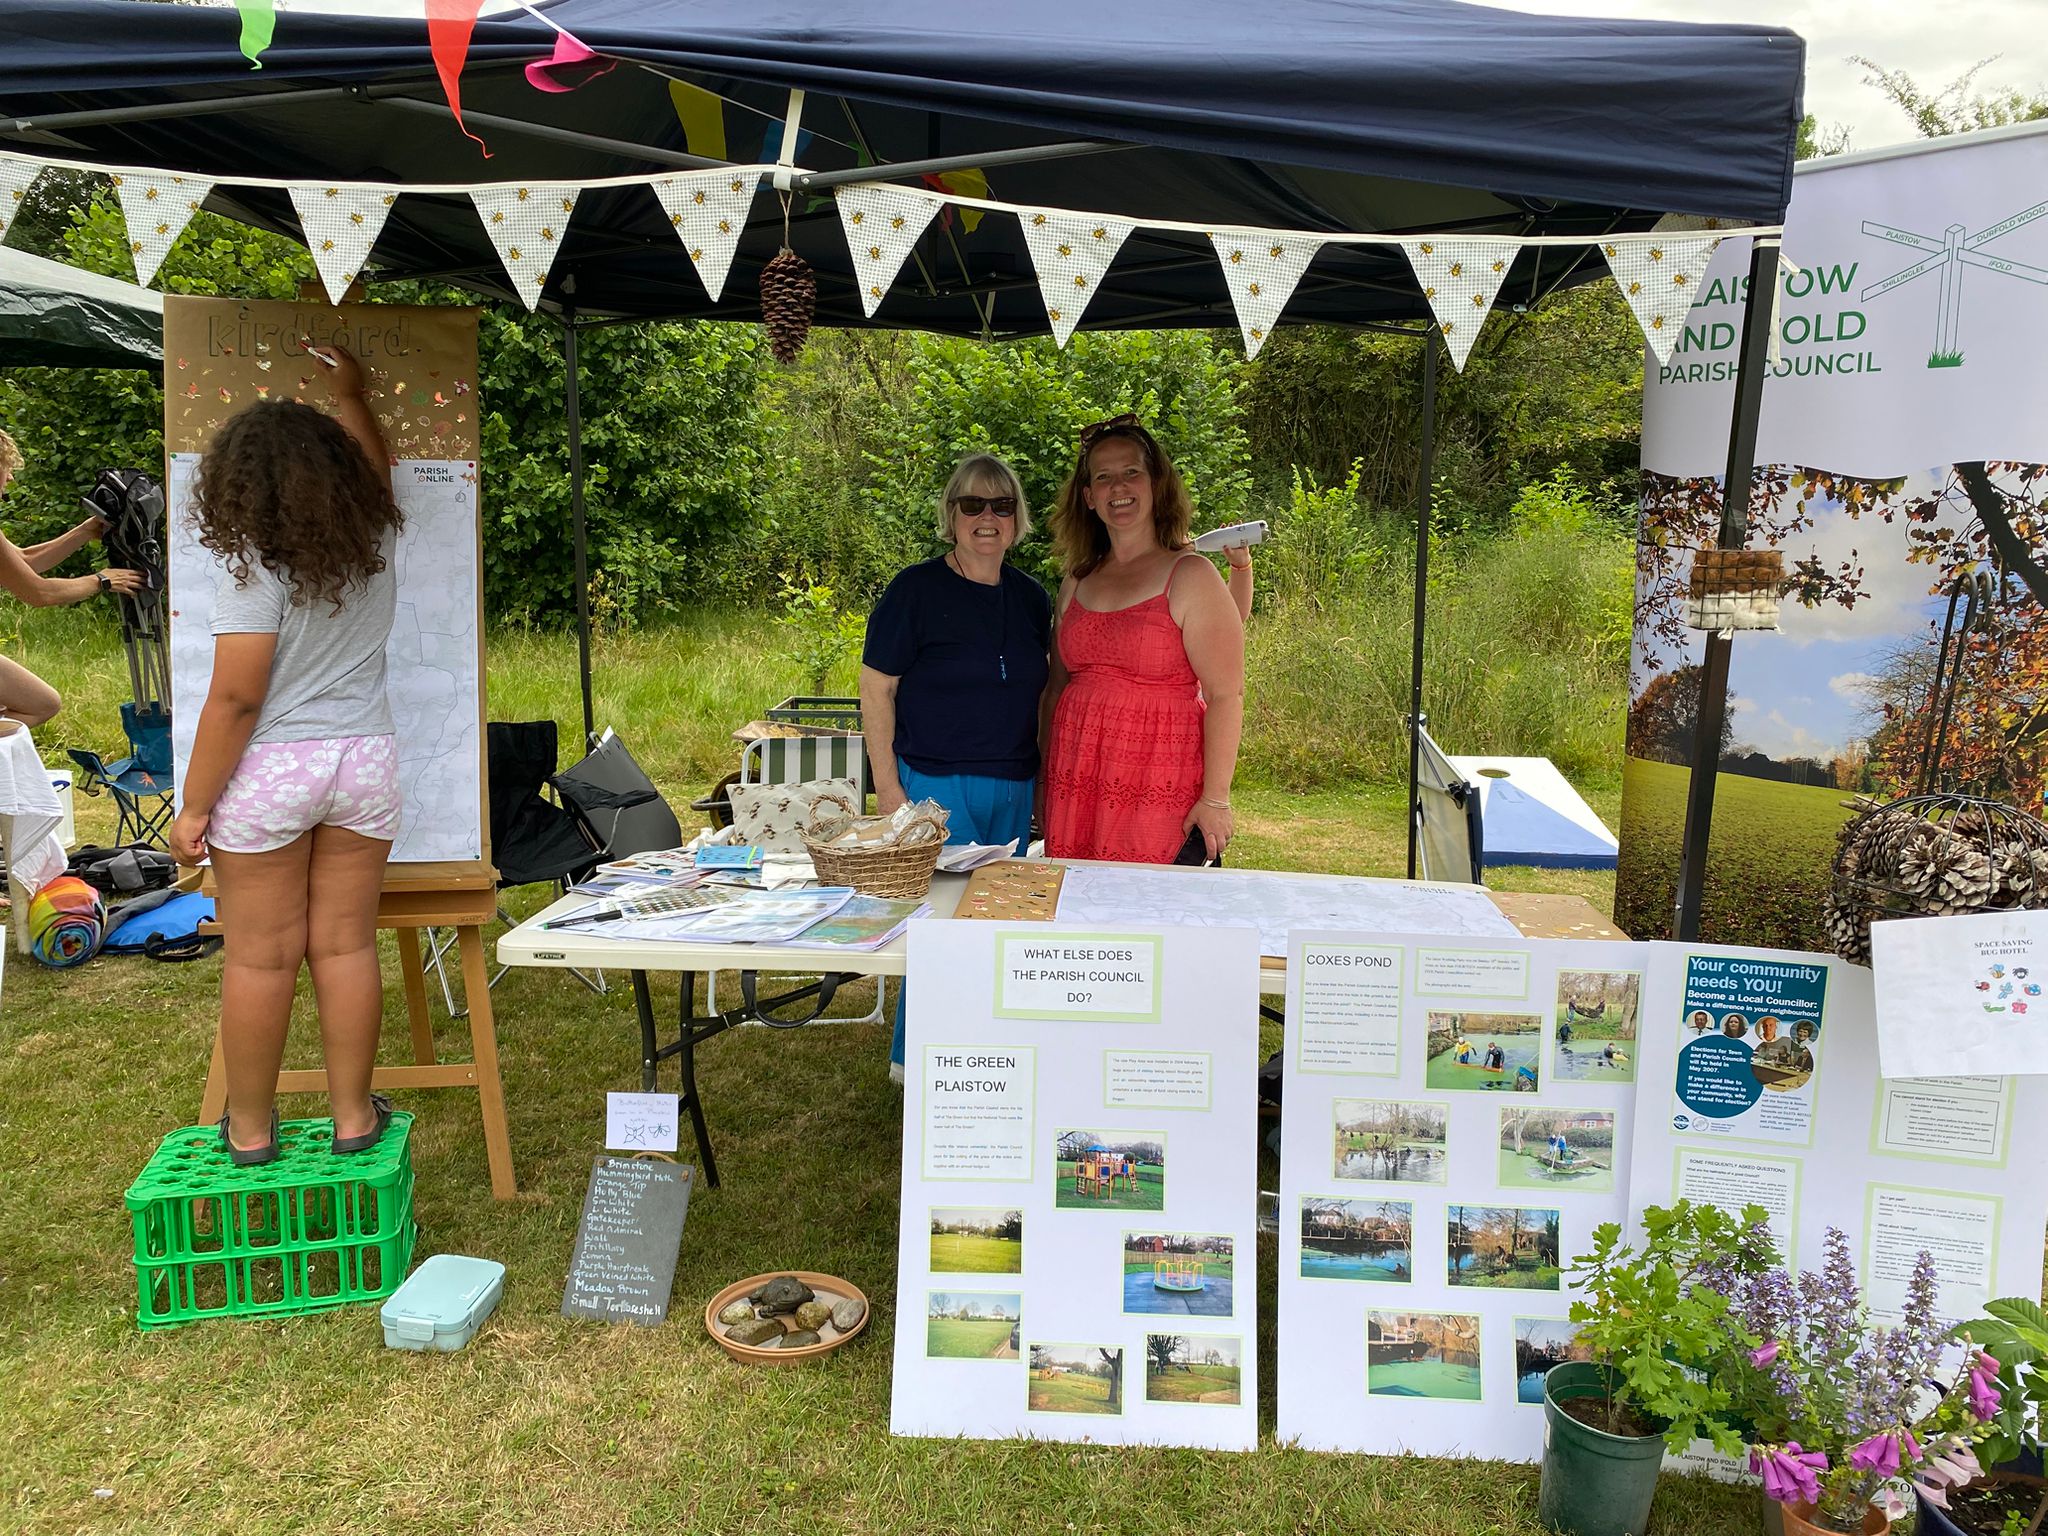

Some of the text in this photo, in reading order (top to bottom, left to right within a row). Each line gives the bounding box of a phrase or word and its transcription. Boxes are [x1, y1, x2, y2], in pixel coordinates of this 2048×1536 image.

[1976, 206, 2047, 242] DURFOLD WOOD
[1885, 230, 1921, 246] PLAISTOW
[1989, 260, 2013, 271] IFOLD
[1881, 265, 1926, 290] SHILLINGLEE
[1674, 311, 1867, 353] ND OLD
[414, 467, 449, 475] PARISH
[417, 475, 455, 483] ONLINE
[1024, 949, 1133, 961] WHAT ELSE DOES
[1306, 954, 1392, 968] COXES POND
[1012, 970, 1144, 982] THE PARISH COUNCIL
[1690, 957, 1821, 983] Your community
[1689, 975, 1782, 993] needs YOU!
[1067, 992, 1093, 1003] DO?
[1688, 990, 1726, 1001] Become
[1737, 994, 1763, 1003] Local
[1766, 996, 1818, 1009] Councillor:
[1712, 1002, 1745, 1010] difference
[1770, 1008, 1820, 1017] neighbourhood
[934, 1056, 1015, 1068] THE GREEN
[935, 1080, 1006, 1092] PLAISTOW
[597, 1167, 651, 1182] Hummingbird
[1756, 1165, 1785, 1173] QUESTIONS
[596, 1178, 647, 1192] Orange Tip
[595, 1186, 642, 1199] Holly Blue
[584, 1233, 607, 1241] Wall
[575, 1280, 648, 1296] Meadow Brown
[571, 1293, 599, 1309] Small
